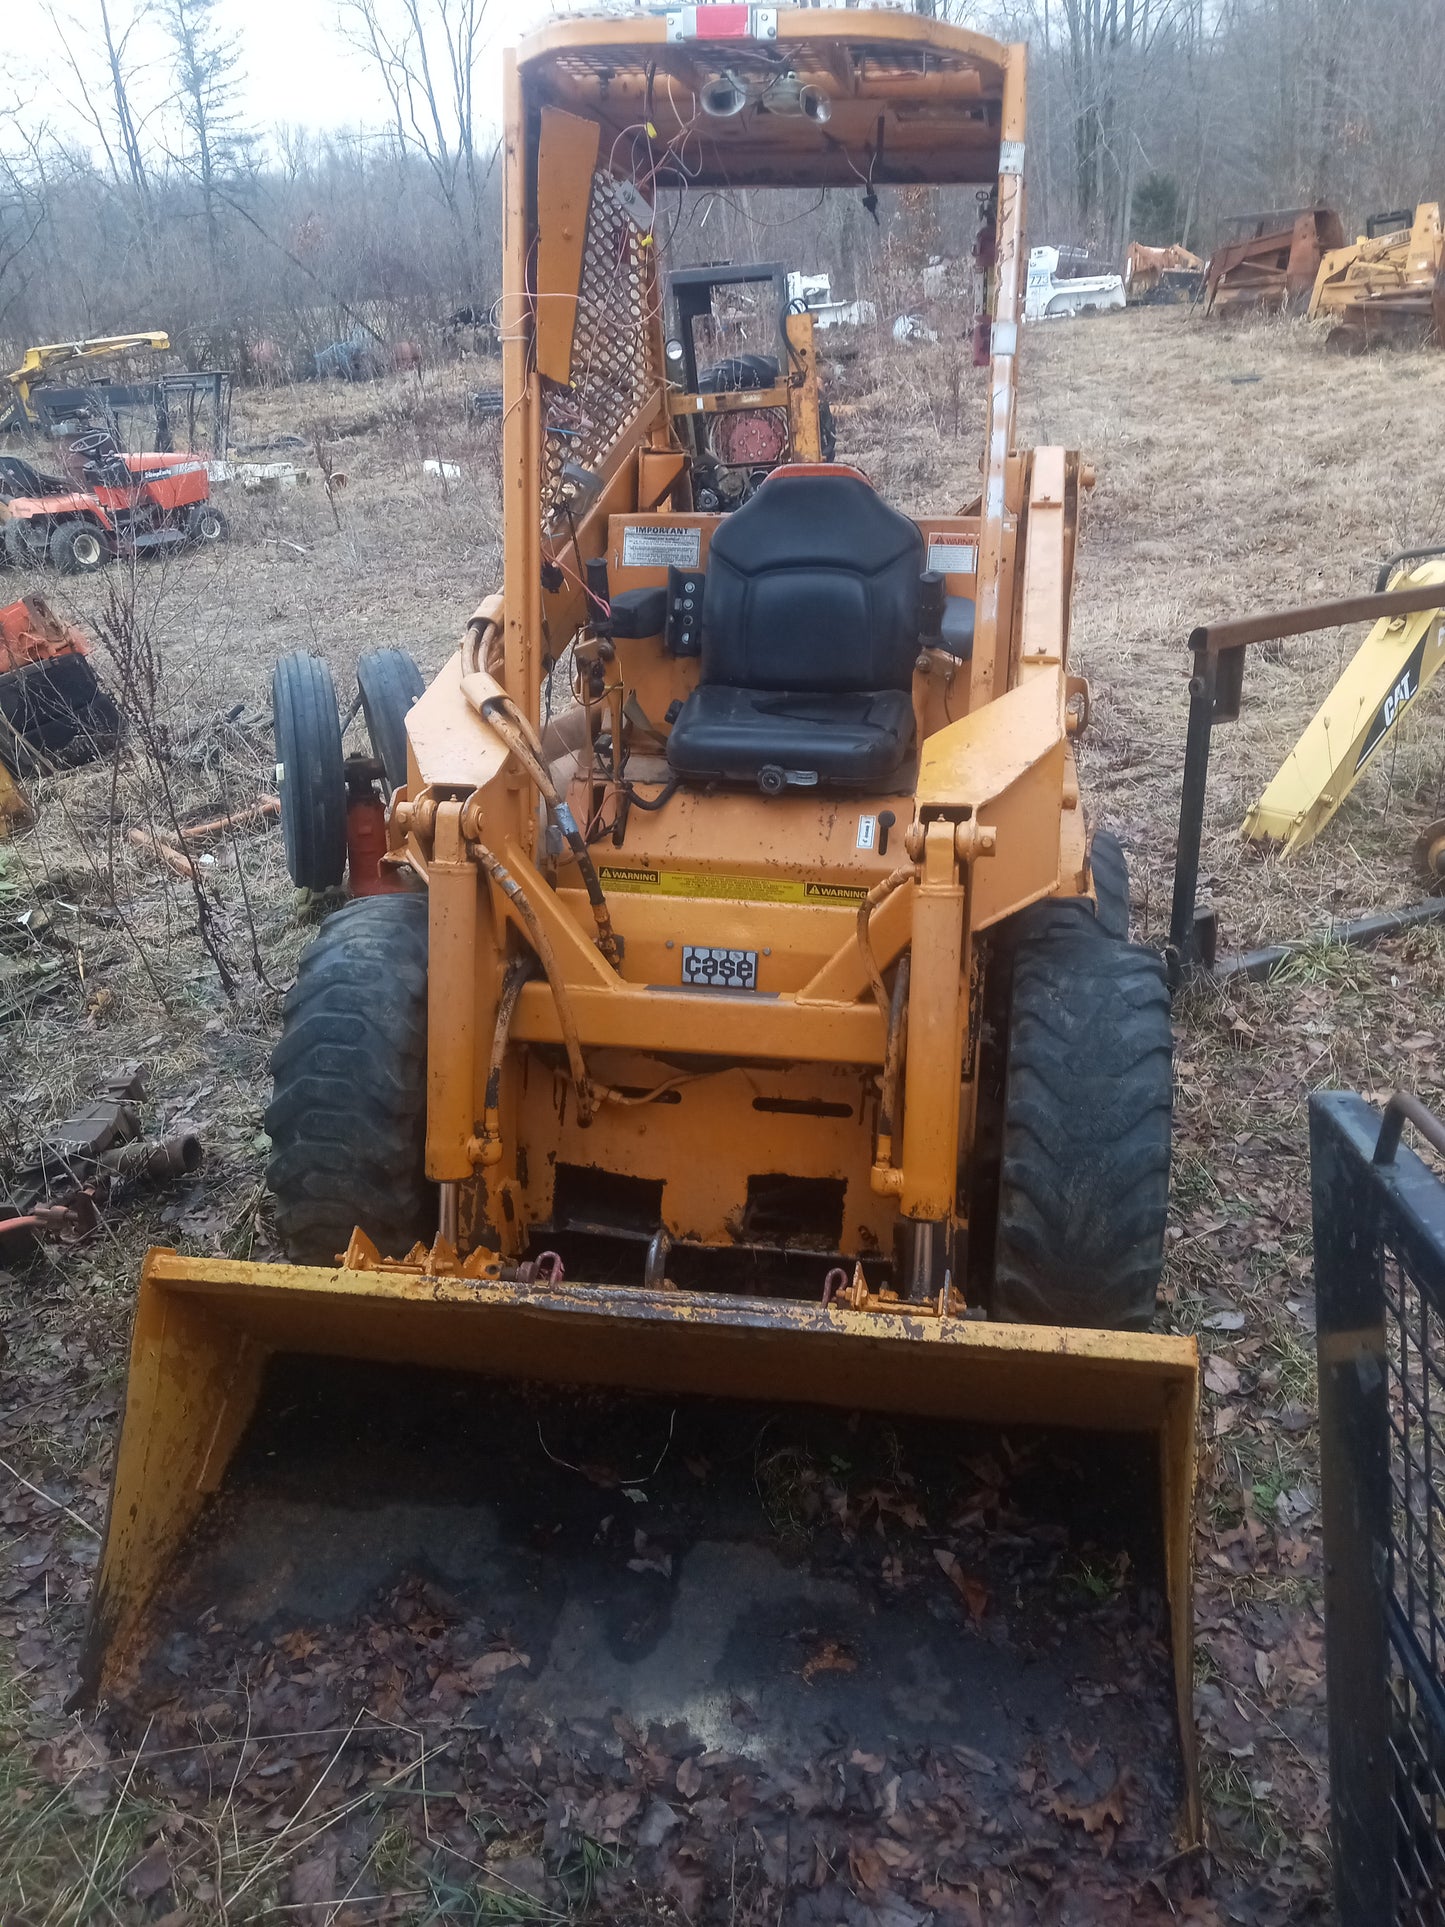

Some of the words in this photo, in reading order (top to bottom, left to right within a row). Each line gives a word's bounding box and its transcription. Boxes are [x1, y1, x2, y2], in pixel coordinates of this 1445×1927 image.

[635, 526, 689, 535] IMPORTANT
[1383, 669, 1411, 727] CAT
[612, 870, 656, 882] WARNING
[821, 887, 867, 899] WARNING
[684, 951, 754, 985] case
